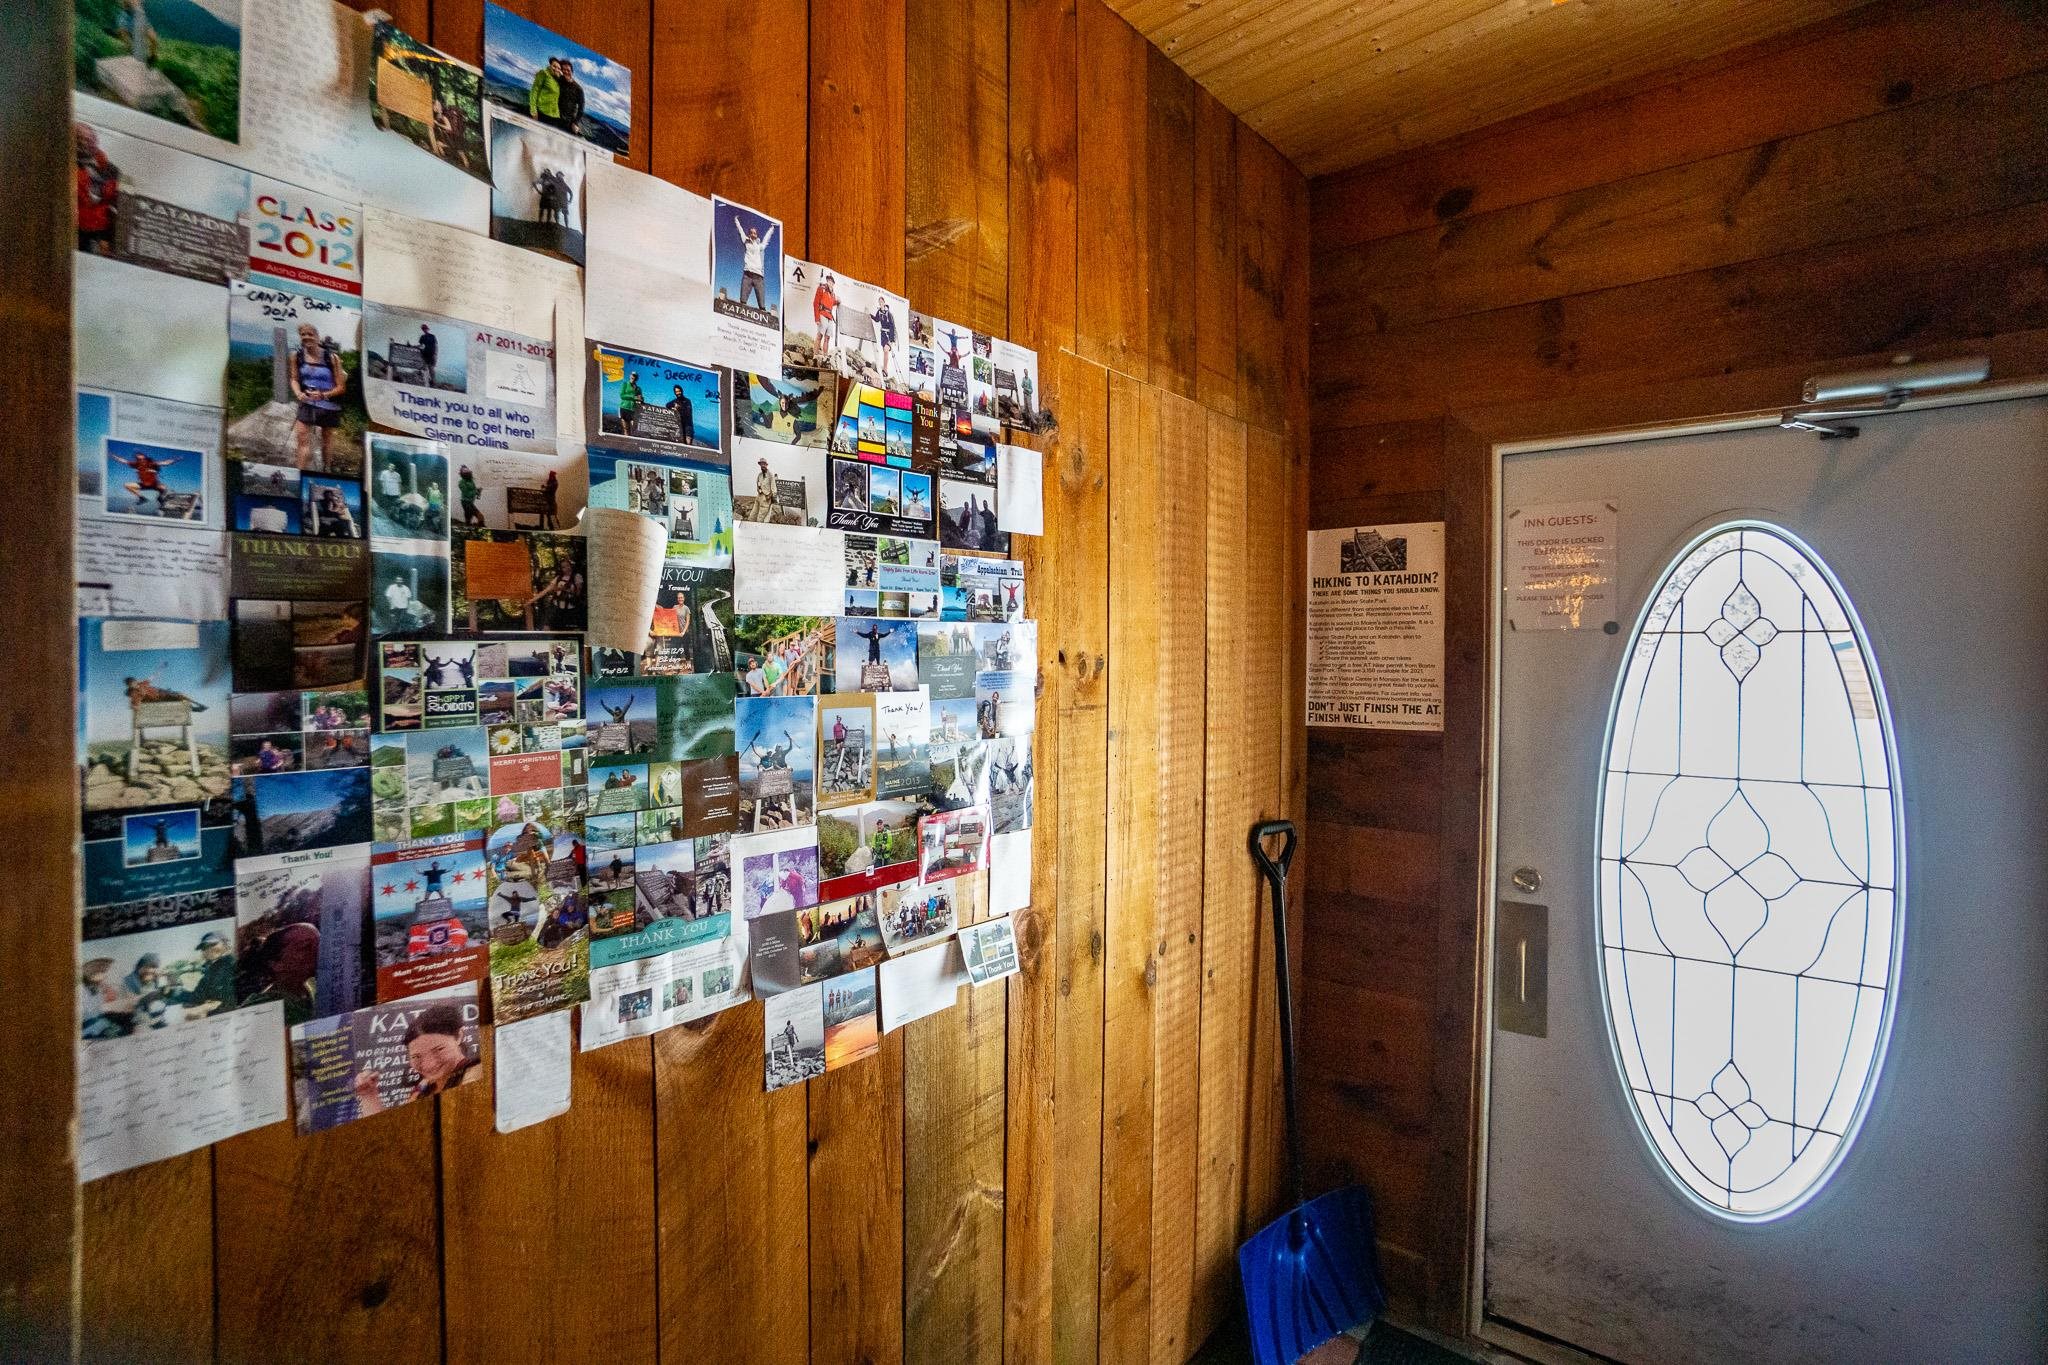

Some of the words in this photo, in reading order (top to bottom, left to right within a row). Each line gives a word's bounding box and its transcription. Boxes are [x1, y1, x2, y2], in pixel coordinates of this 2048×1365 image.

[256, 195, 354, 237] CLASS
[256, 222, 354, 271] 2012
[263, 305, 298, 318] 2012
[722, 303, 769, 323] KATAHDIN
[476, 332, 494, 344] AT
[496, 336, 554, 358] 2011-2012
[398, 390, 441, 409] Thank
[445, 401, 469, 414] you
[473, 405, 484, 416] to
[488, 408, 502, 418] all
[505, 411, 530, 424] who
[915, 403, 938, 418] Thank
[393, 406, 438, 425] helped
[442, 416, 463, 428] me
[467, 418, 479, 431] to
[482, 422, 502, 435] get
[505, 426, 535, 440] here!
[920, 415, 934, 428] You
[425, 427, 464, 444] Glenn
[467, 434, 510, 450] Collins
[830, 512, 860, 526] Thank
[860, 513, 880, 530] You
[1524, 519, 1544, 528] INN
[1548, 514, 1598, 527] GUESTS:
[1570, 536, 1605, 544] LOCKED
[676, 570, 704, 582] YOU!
[977, 565, 1008, 576] Appalachian
[1312, 576, 1352, 588] HIKING
[1355, 576, 1370, 586] TO
[1374, 572, 1438, 586] KATAHDIN?
[1361, 588, 1382, 596] THINGS
[881, 706, 904, 714] Thank
[905, 702, 924, 715] You!
[1308, 701, 1335, 711] DON'T
[1338, 702, 1360, 712] JUST
[1364, 703, 1398, 714] FINISH
[1402, 704, 1422, 714] THE
[1426, 704, 1442, 715] AT.
[1308, 712, 1340, 722] FINISH
[1343, 714, 1372, 724] WELL.
[518, 754, 558, 764] CHRISTMAS!
[396, 836, 436, 849] THANK
[438, 833, 465, 844] YOU!
[281, 853, 311, 864] Thank
[314, 850, 333, 860] You!
[620, 928, 674, 949] THANK
[682, 920, 708, 936] YOU
[494, 968, 542, 990] THANK
[542, 954, 578, 977] YOU!
[988, 963, 1002, 974] Thank
[1002, 958, 1014, 968] You!
